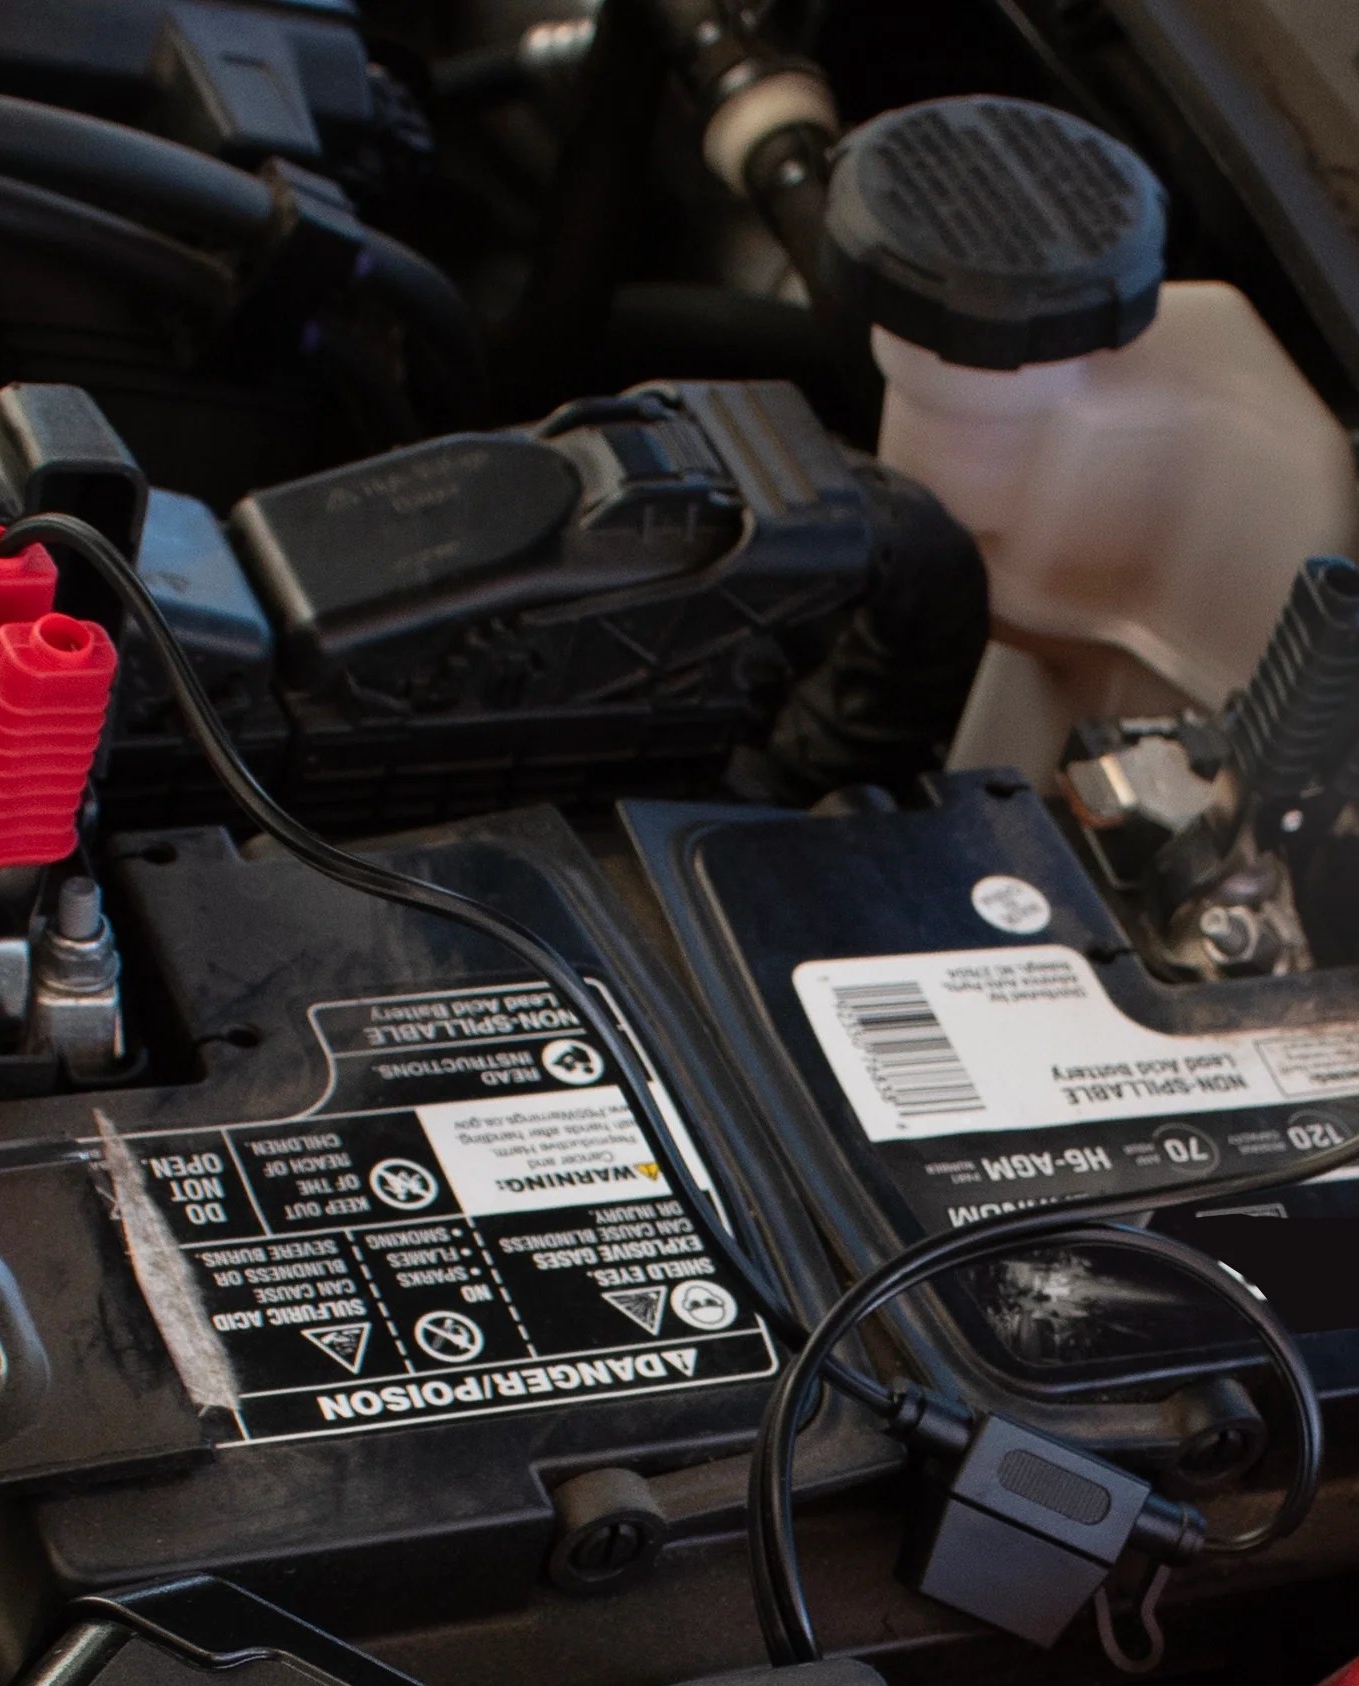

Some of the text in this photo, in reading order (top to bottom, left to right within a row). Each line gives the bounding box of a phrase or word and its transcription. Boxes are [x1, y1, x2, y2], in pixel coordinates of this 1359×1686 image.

[369, 991, 560, 1025] Lead Acid Battery
[363, 1008, 582, 1047] NON-SPILLABLE
[372, 1048, 535, 1082] INSTRUCTIONS.
[481, 1067, 543, 1087] READ
[1051, 1052, 1236, 1081] Lead Acid Battery
[1060, 1074, 1248, 1105] NON-SPILLABLE
[244, 1131, 343, 1157] CHILDREN.
[539, 1134, 638, 1151] Reproductive
[1162, 1136, 1210, 1163] 70
[1286, 1122, 1346, 1151] 120
[141, 1152, 224, 1179] OPEN.
[263, 1151, 353, 1179] REACH OF
[526, 1150, 615, 1170] Cancer and
[980, 1145, 1113, 1183] H6-AGM
[169, 1177, 226, 1202] NOT
[294, 1172, 362, 1197] OF THE
[495, 1165, 638, 1193] WARNING:
[184, 1202, 229, 1226] DO
[284, 1194, 372, 1221] KEEP OUT
[589, 1200, 685, 1225] OR INJURY.
[364, 1227, 452, 1251] SMOKING
[498, 1218, 695, 1253] CAN CAUSE BLINDNESS
[195, 1238, 340, 1270] SEVERE BURNS.
[385, 1245, 460, 1269] FLAMES
[531, 1234, 705, 1271] EXPLOSIVE GASES
[212, 1257, 349, 1288] BLINDNESS OR
[395, 1264, 470, 1289] SPARKS
[585, 1256, 717, 1288] SHIELD EYES.
[253, 1277, 358, 1304] CAN CAUSE
[459, 1283, 494, 1303] NO
[212, 1298, 368, 1332] SULFURIC ACID
[315, 1349, 670, 1422] DANGER/POISON
